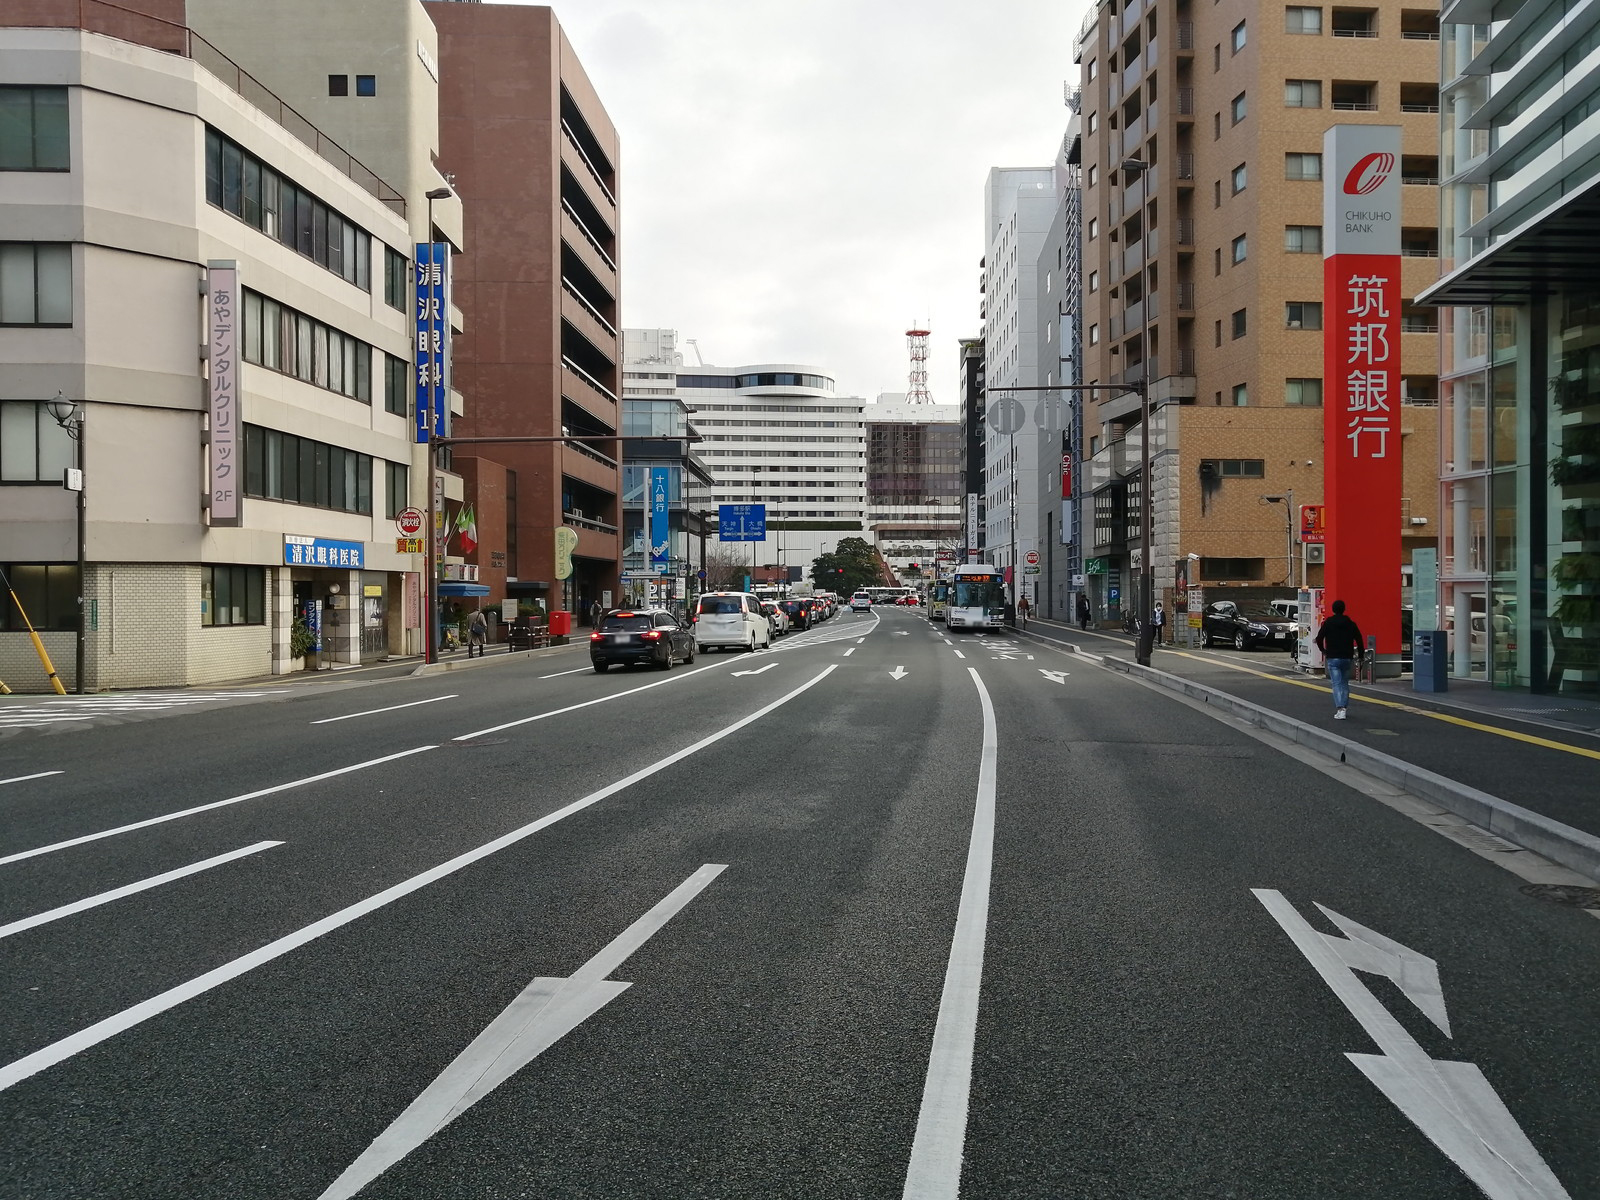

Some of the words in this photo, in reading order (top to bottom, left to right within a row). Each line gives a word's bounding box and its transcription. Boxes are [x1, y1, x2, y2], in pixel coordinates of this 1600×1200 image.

[1345, 211, 1392, 221] CHIKUHO
[1345, 224, 1374, 233] BANK
[1347, 274, 1390, 459] 筑邦銀行
[213, 290, 231, 479] あやデンタルクリニック
[1062, 455, 1071, 476] Chic
[215, 490, 232, 501] 2F
[655, 475, 665, 513] 十八銀行
[397, 539, 408, 553] 質
[292, 545, 359, 567] 清沢眼科医院
[1111, 589, 1119, 599] P
